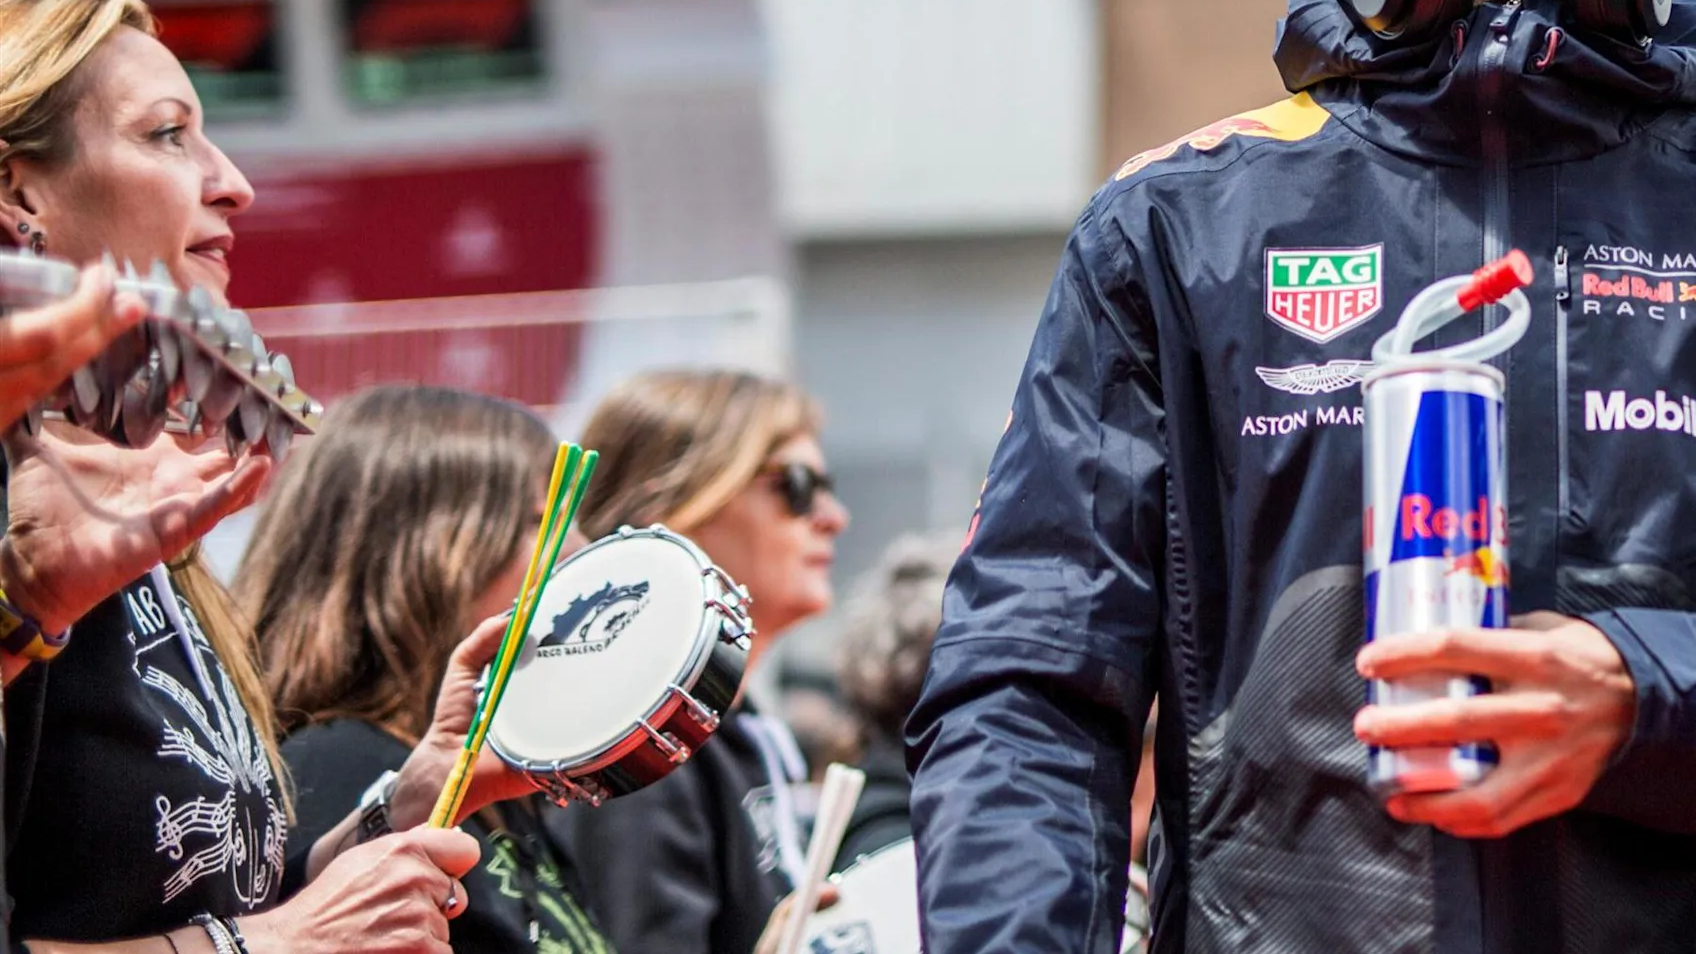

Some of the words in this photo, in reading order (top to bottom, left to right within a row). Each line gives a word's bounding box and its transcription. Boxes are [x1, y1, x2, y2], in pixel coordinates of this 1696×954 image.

[1583, 244, 1653, 267] ASTON
[1277, 256, 1372, 286] TAG
[1274, 288, 1374, 333] HEUER
[1241, 409, 1308, 437] ASTON
[1401, 493, 1488, 541] Red
